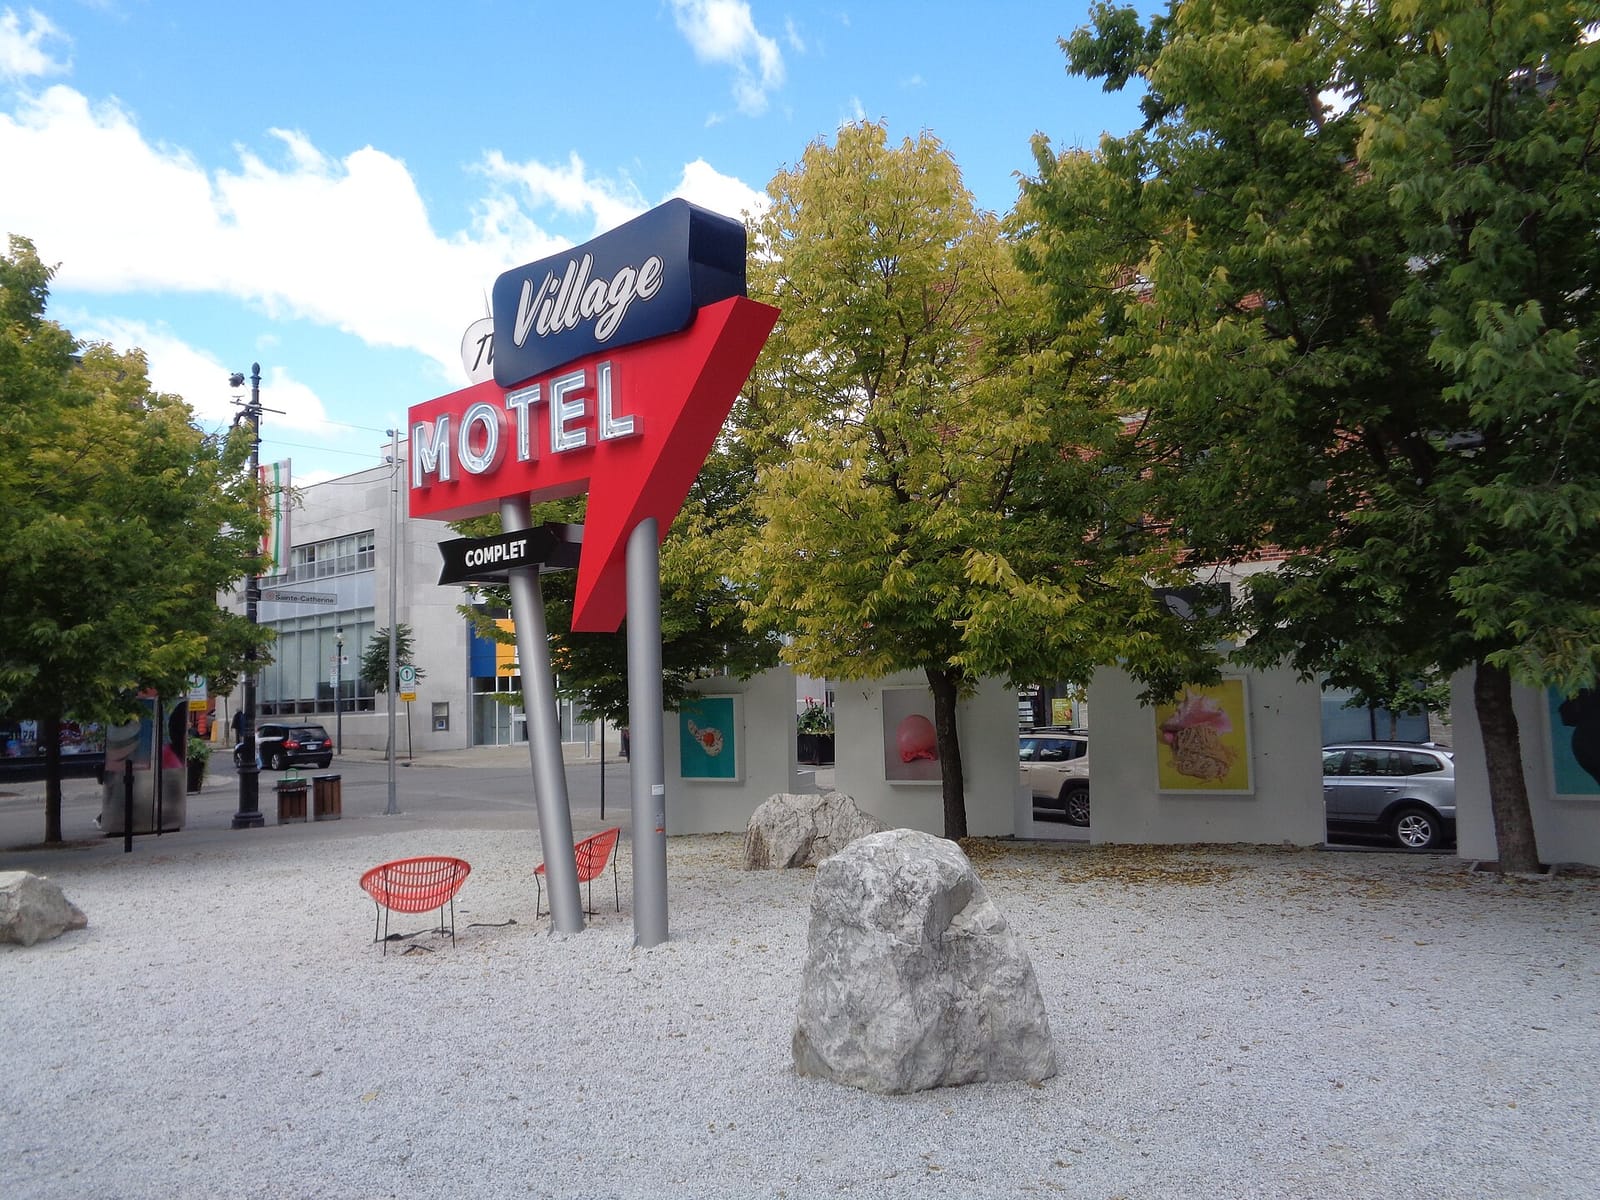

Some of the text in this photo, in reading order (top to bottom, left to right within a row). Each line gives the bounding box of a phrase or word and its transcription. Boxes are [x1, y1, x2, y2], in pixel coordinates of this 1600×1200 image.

[513, 252, 664, 348] Village
[411, 360, 639, 489] MOTEL
[464, 539, 527, 567] COMPLET
[274, 594, 335, 604] Sainte-Catherine
